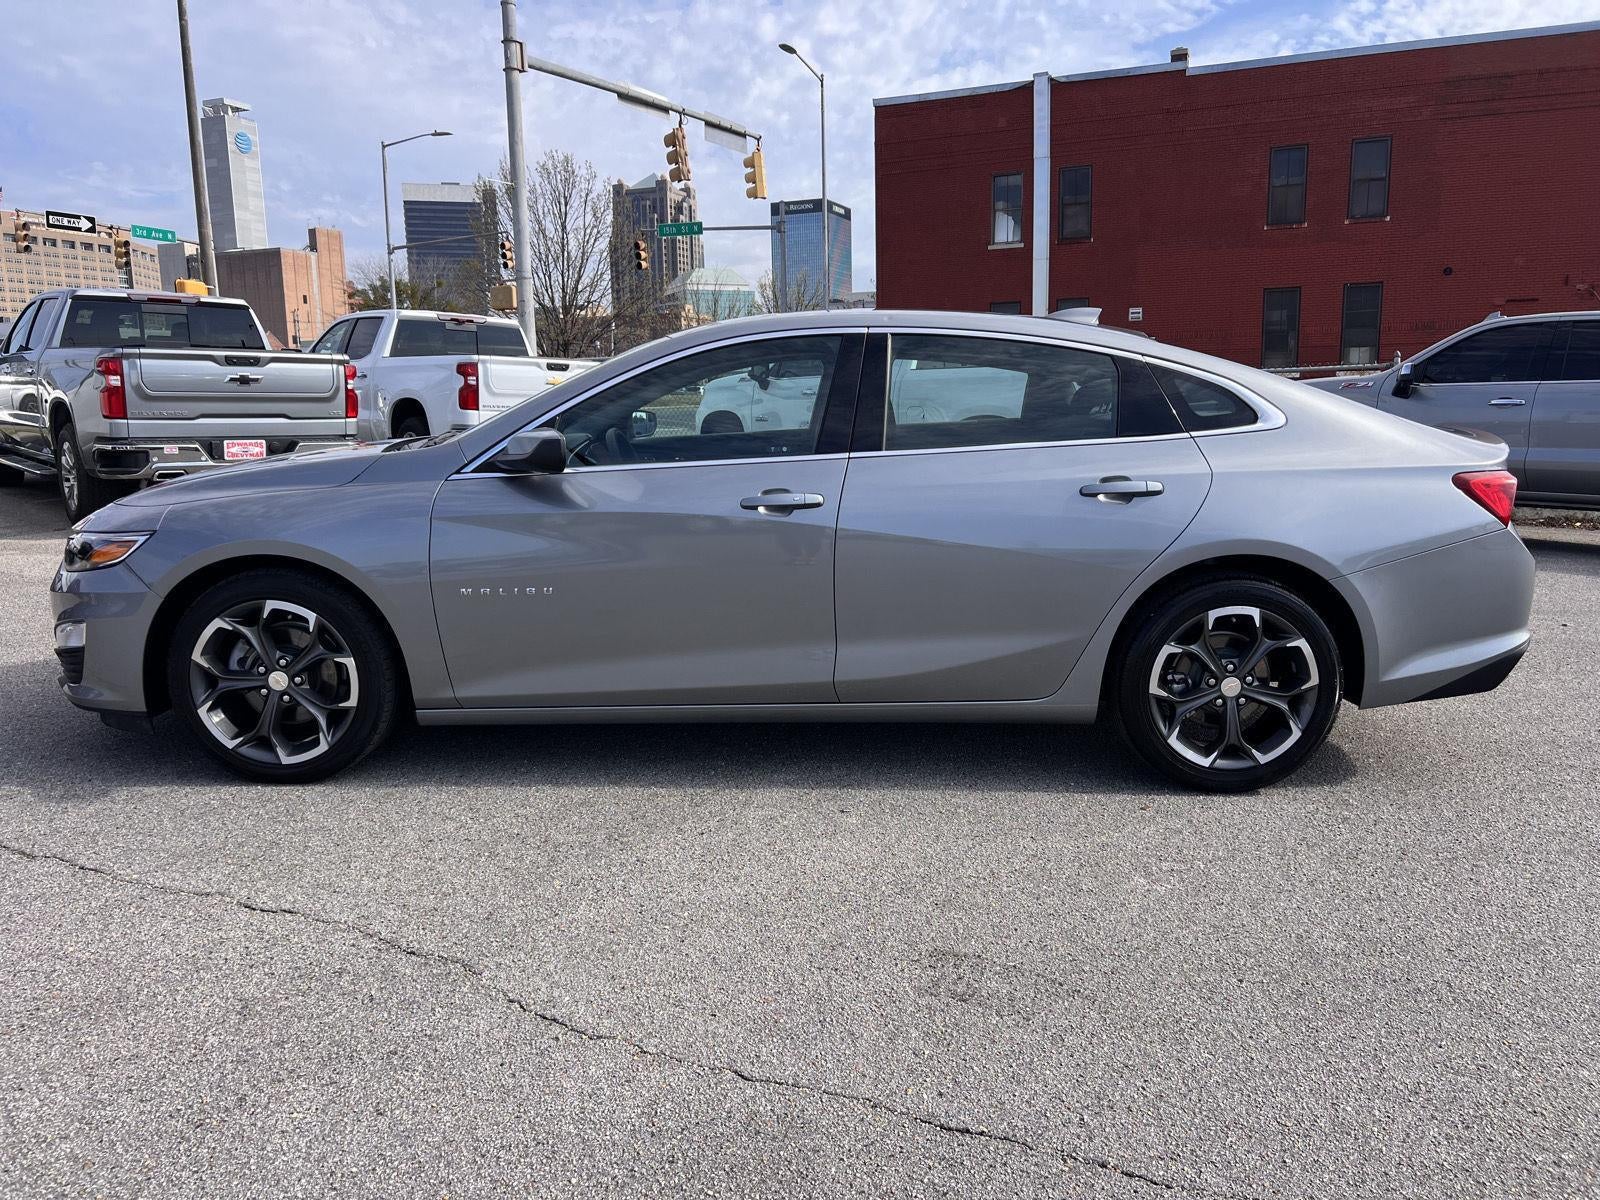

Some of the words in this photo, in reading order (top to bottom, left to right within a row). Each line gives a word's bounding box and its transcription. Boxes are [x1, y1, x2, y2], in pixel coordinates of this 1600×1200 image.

[51, 217, 65, 225] ONE
[66, 219, 81, 227] WAY
[135, 228, 147, 237] 3rd
[151, 231, 163, 239] Ave
[663, 226, 677, 235] 15th
[681, 225, 689, 233] St
[693, 224, 699, 232] N
[226, 441, 264, 449] EDWARDS
[226, 450, 264, 459] CHEVYMAN
[460, 587, 553, 596] MALIBU
